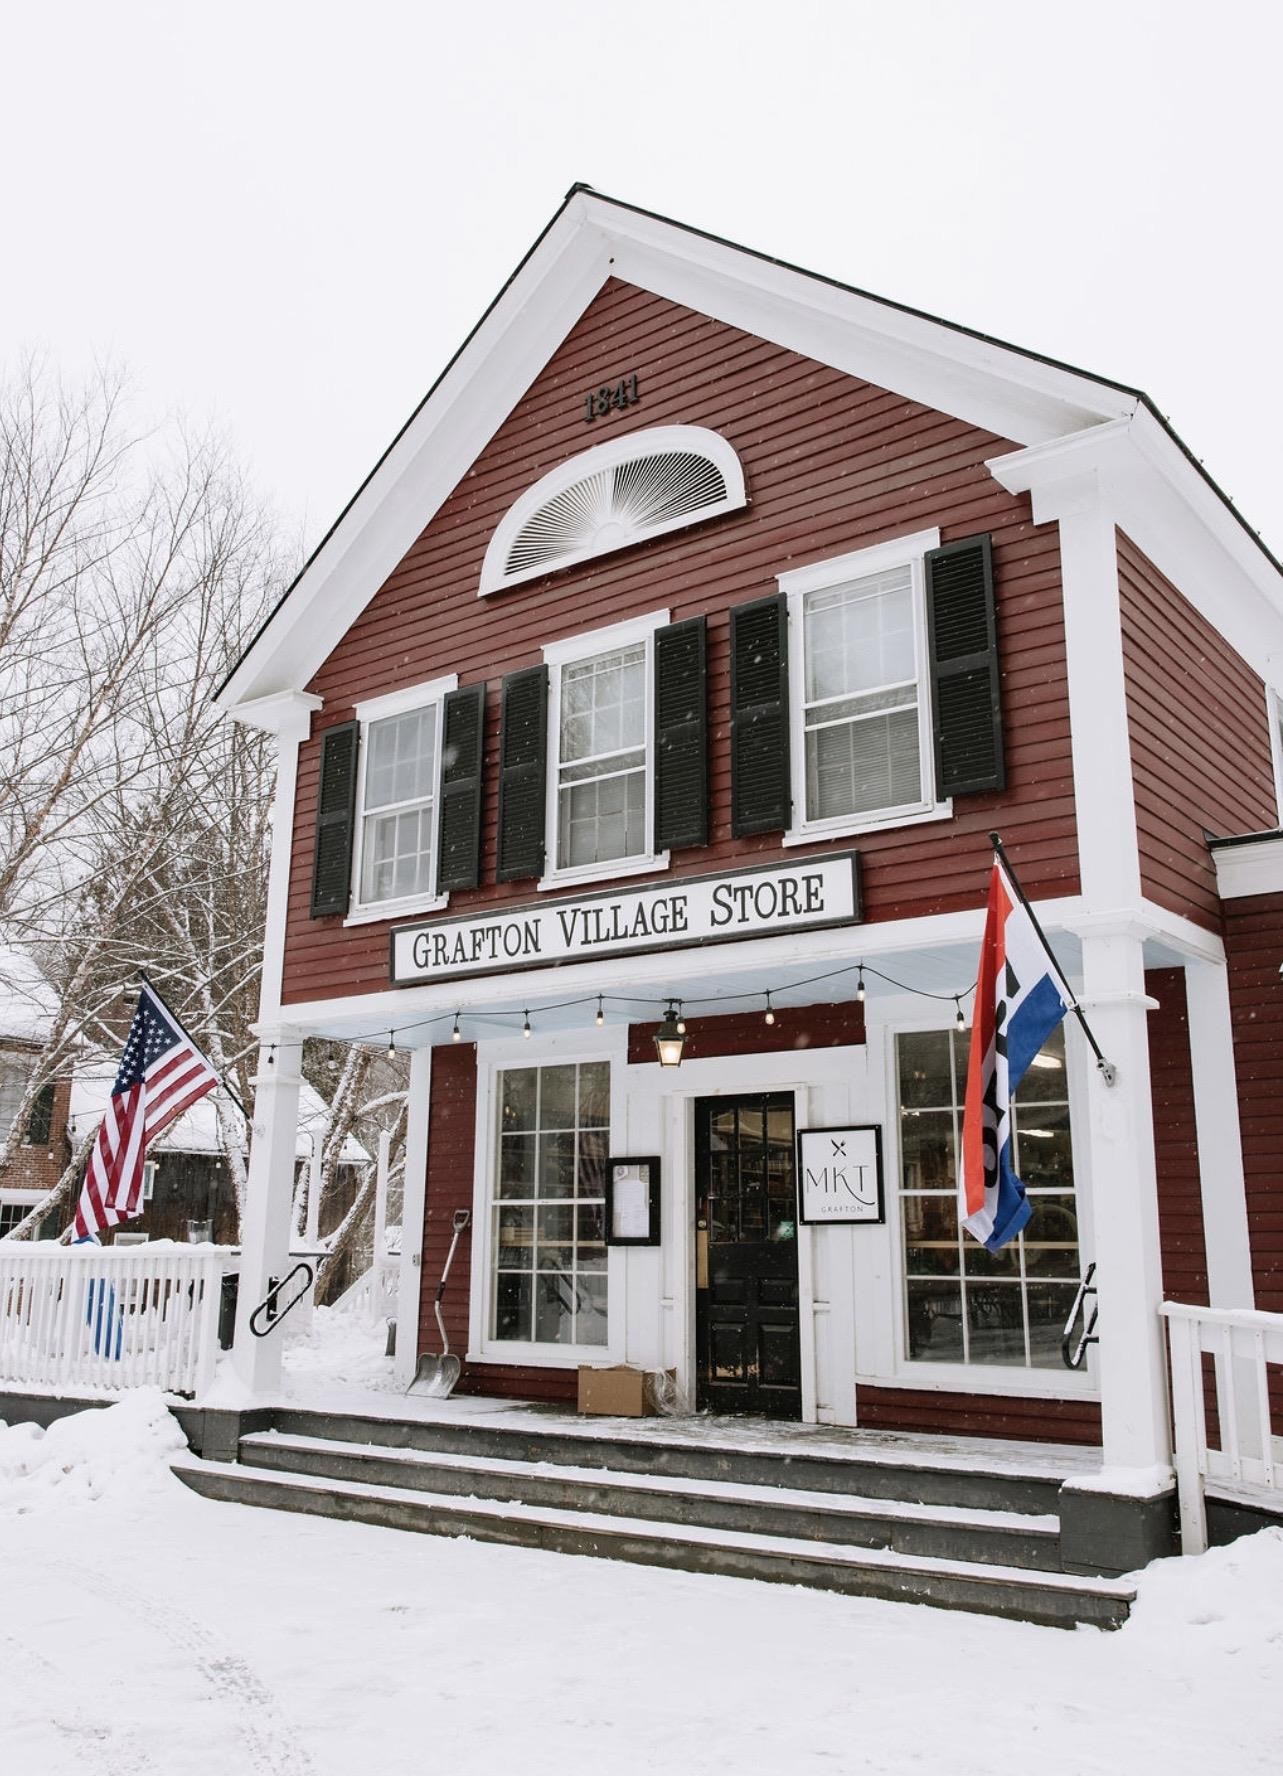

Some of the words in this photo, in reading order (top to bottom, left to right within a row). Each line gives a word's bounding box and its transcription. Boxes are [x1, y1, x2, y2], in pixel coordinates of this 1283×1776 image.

[584, 374, 639, 423] 1841
[412, 918, 542, 969] GRAFTON
[556, 895, 688, 947] VILLAGE
[710, 873, 825, 927] STORE
[805, 1165, 876, 1205] MKT
[821, 1205, 864, 1213] GRAFTON
